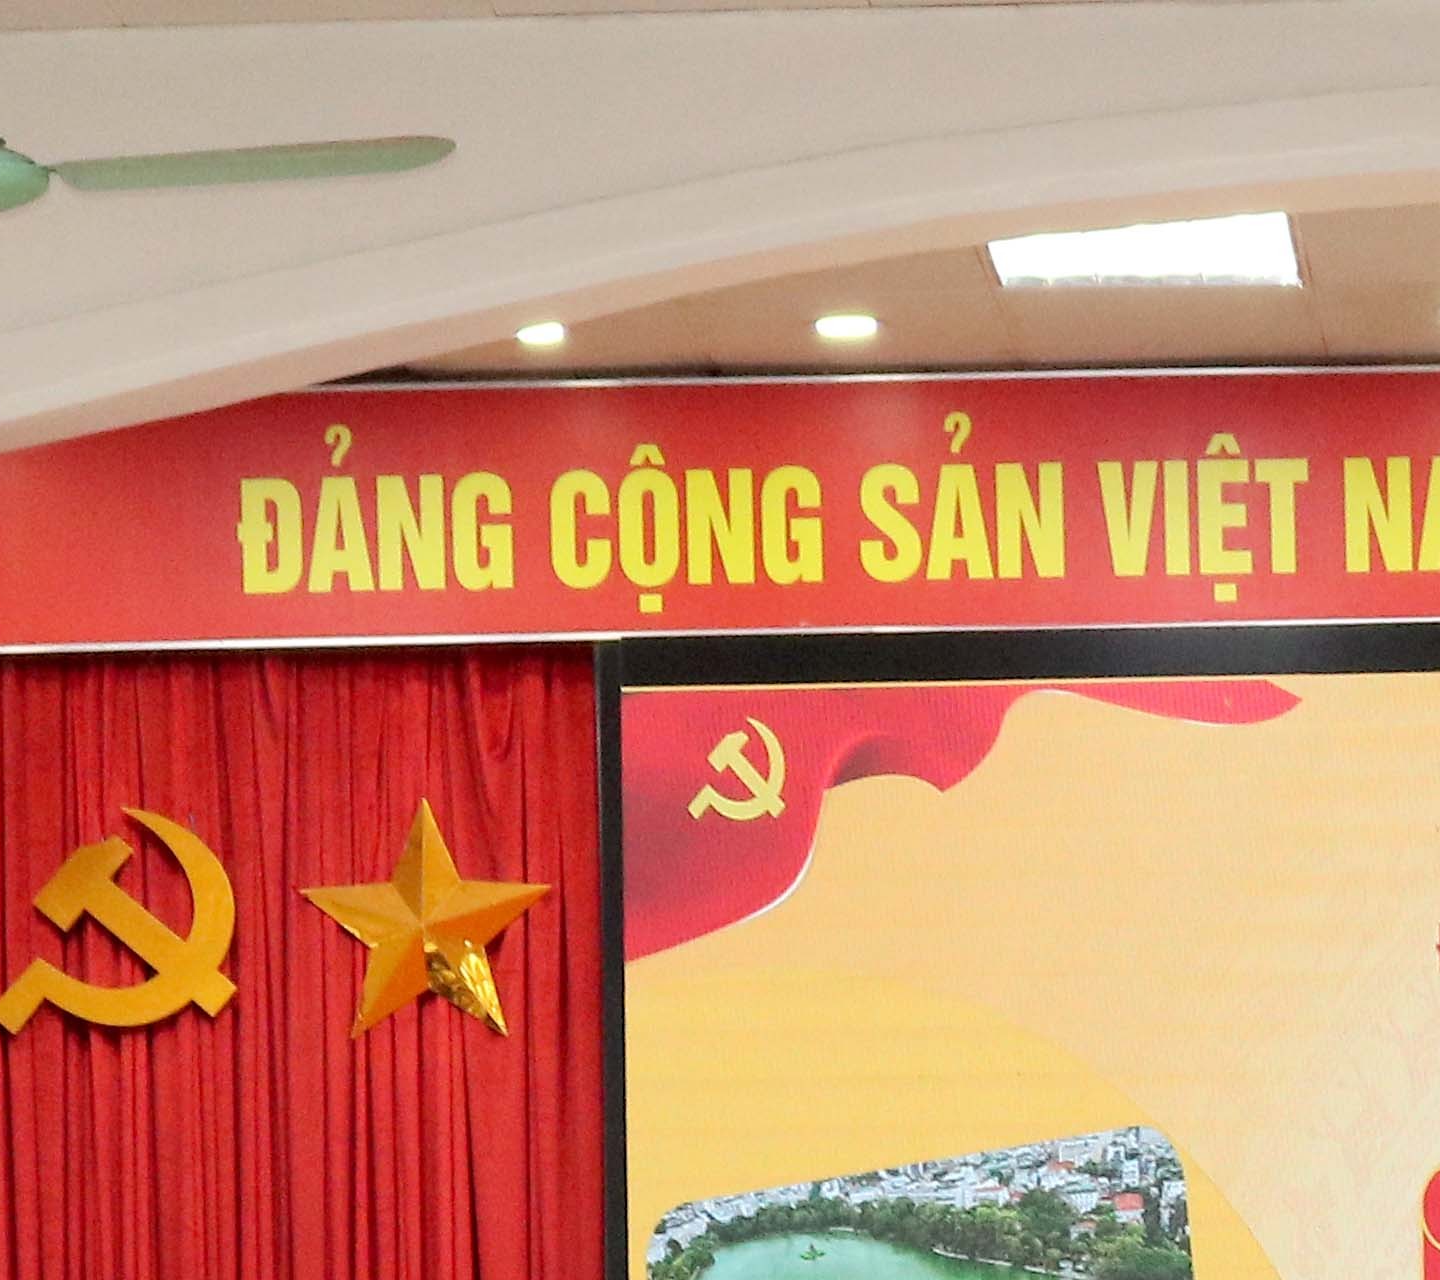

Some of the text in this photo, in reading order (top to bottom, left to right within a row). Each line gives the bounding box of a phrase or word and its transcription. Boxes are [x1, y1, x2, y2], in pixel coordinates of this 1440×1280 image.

[237, 426, 514, 594] ĐẢNG
[550, 444, 824, 614] CỘNG
[860, 412, 1066, 583] SẢN
[1098, 434, 1308, 602] VIỆT
